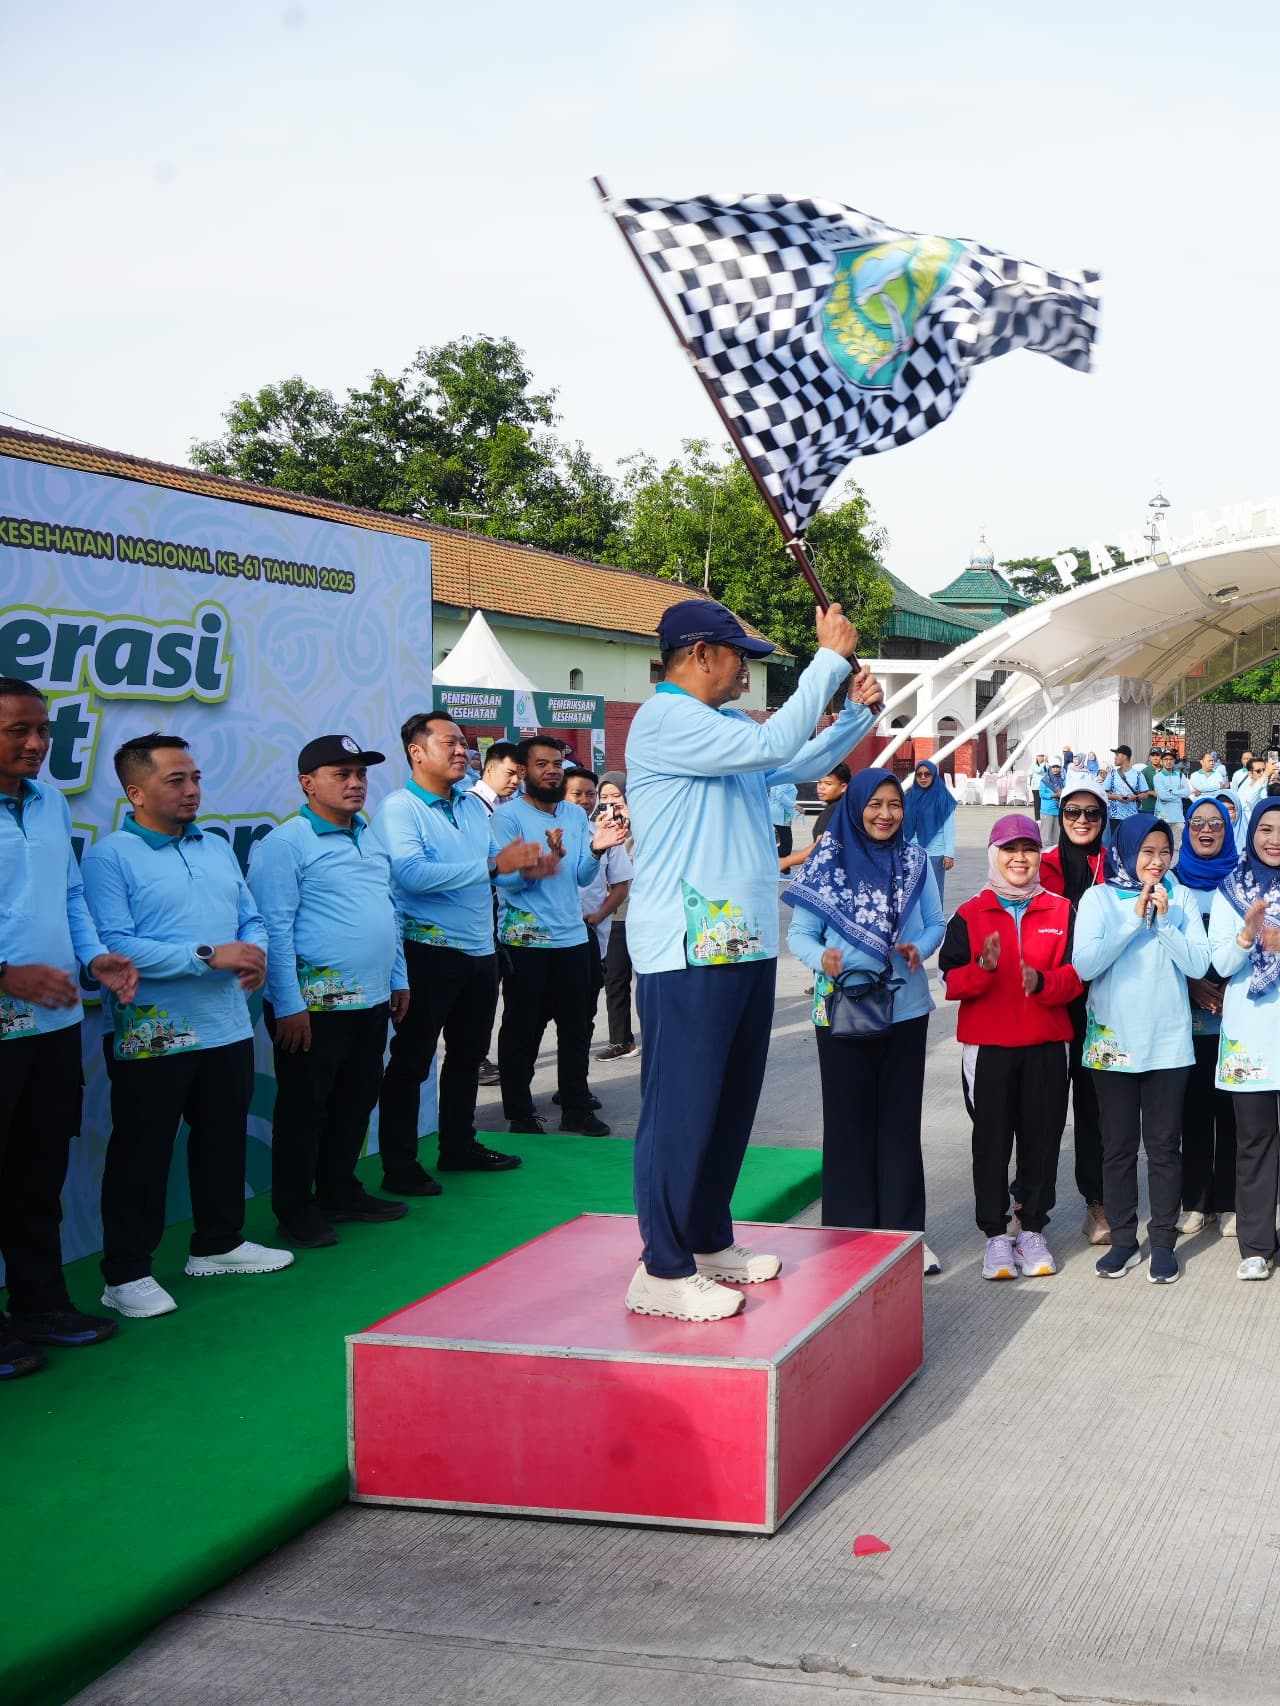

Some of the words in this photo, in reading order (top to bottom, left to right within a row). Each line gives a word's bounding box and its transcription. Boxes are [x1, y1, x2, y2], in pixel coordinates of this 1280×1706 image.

[0, 520, 113, 558] KESEHATAN
[117, 537, 212, 571] NASIONAL
[217, 553, 259, 578] KE-61
[264, 560, 316, 586] TAHUN
[320, 570, 354, 591] 2025
[441, 692, 502, 706] PEMERIKSAAN
[548, 699, 596, 711] PEMERIKSAAN
[448, 706, 498, 720] KESEHATAN
[552, 711, 593, 723] KESEHATAN
